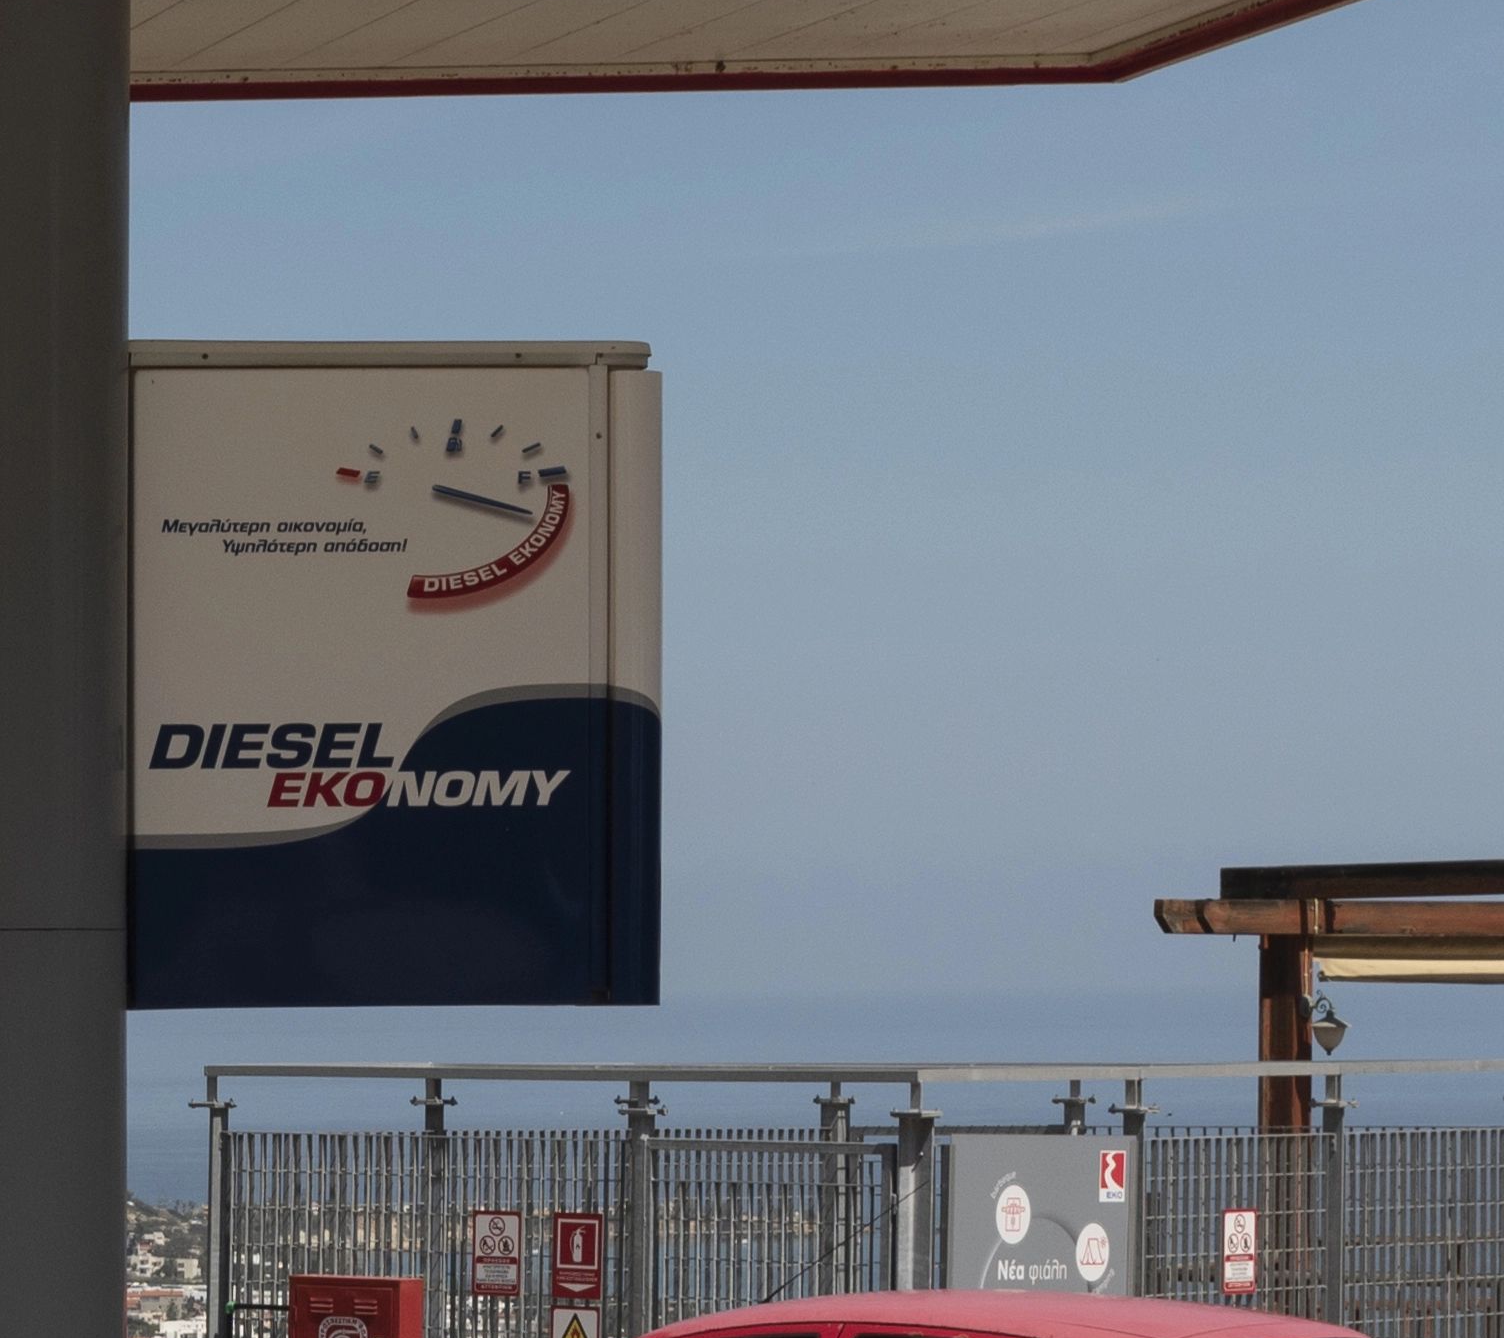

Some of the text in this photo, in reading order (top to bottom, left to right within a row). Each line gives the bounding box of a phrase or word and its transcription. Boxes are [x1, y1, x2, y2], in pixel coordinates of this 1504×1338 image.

[518, 471, 532, 484] F
[161, 518, 367, 536] Μεγαλύτερη οικονομία,
[223, 539, 408, 555] Υψηλότερη απόδοση!
[422, 490, 567, 592] DIESEL EKONOMY
[148, 722, 395, 770] DIESEL
[266, 769, 572, 808] EKONOMY
[1106, 1191, 1123, 1199] EKO
[997, 1259, 1025, 1280] Νέα
[1029, 1259, 1068, 1285] φιάλη
